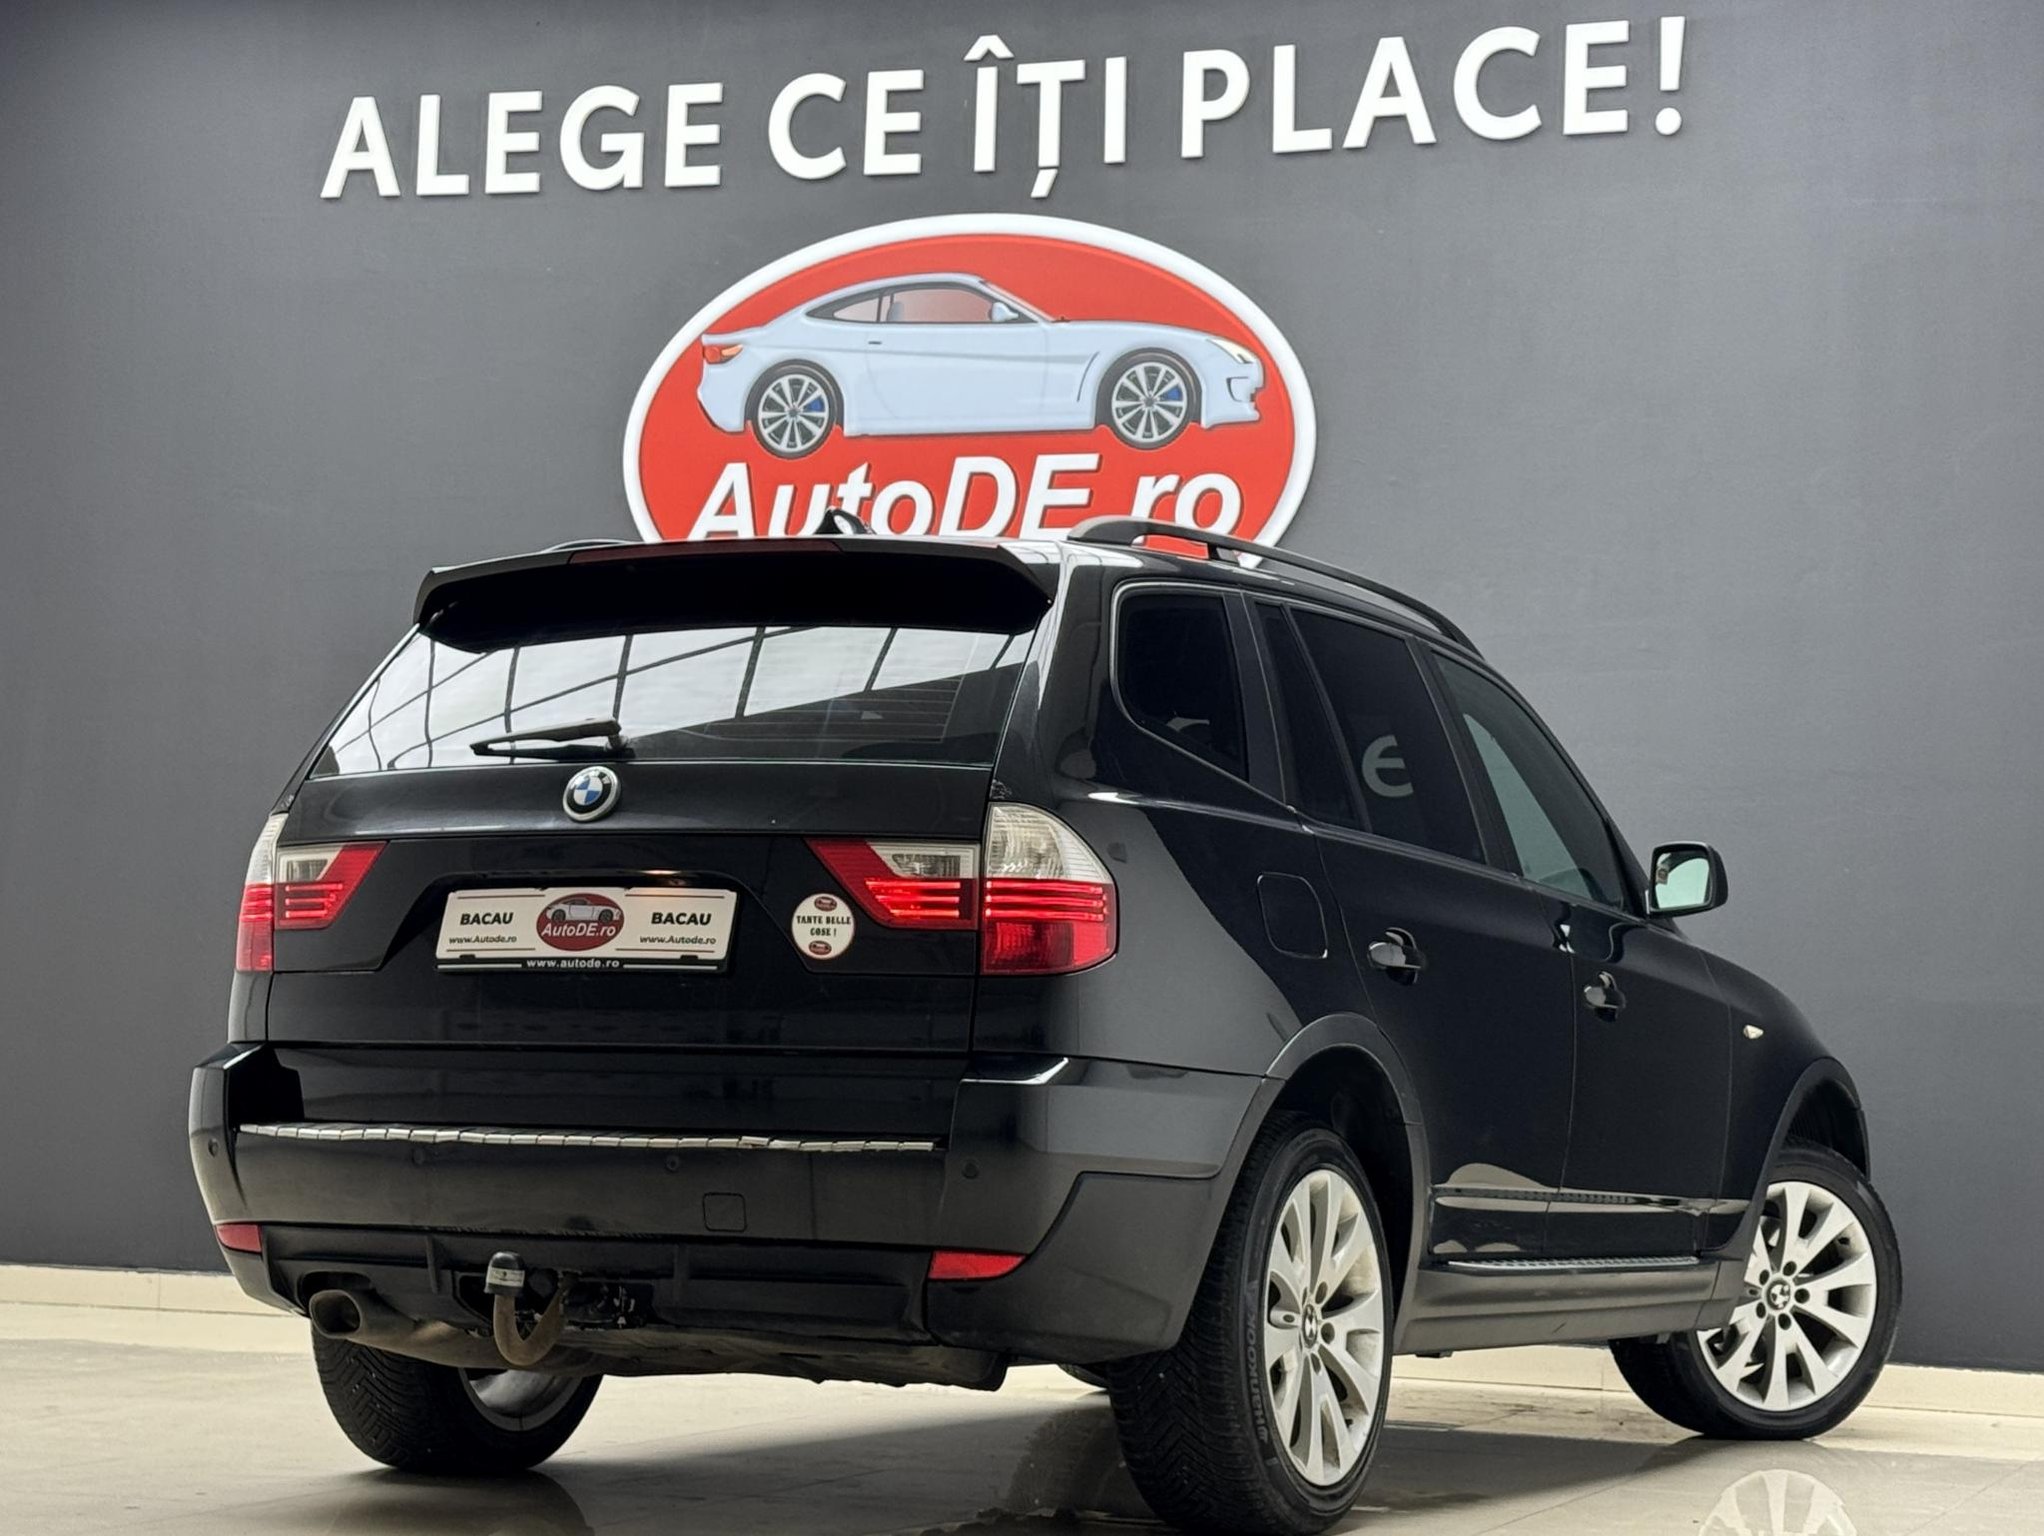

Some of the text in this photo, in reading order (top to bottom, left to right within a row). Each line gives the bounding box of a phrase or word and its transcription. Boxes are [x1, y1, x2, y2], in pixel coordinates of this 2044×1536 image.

[320, 82, 723, 198] ALEGE
[768, 69, 924, 179] CE
[1181, 15, 1687, 160] PLACE!
[460, 912, 513, 926] BACAU
[651, 912, 712, 926] BACAU
[796, 915, 823, 925] TANTE
[541, 922, 616, 938] AutoDE.ro
[449, 935, 517, 944] www.Autode.ro
[640, 935, 717, 945] www.Autode.ro
[526, 958, 620, 969] www.autode.ro
